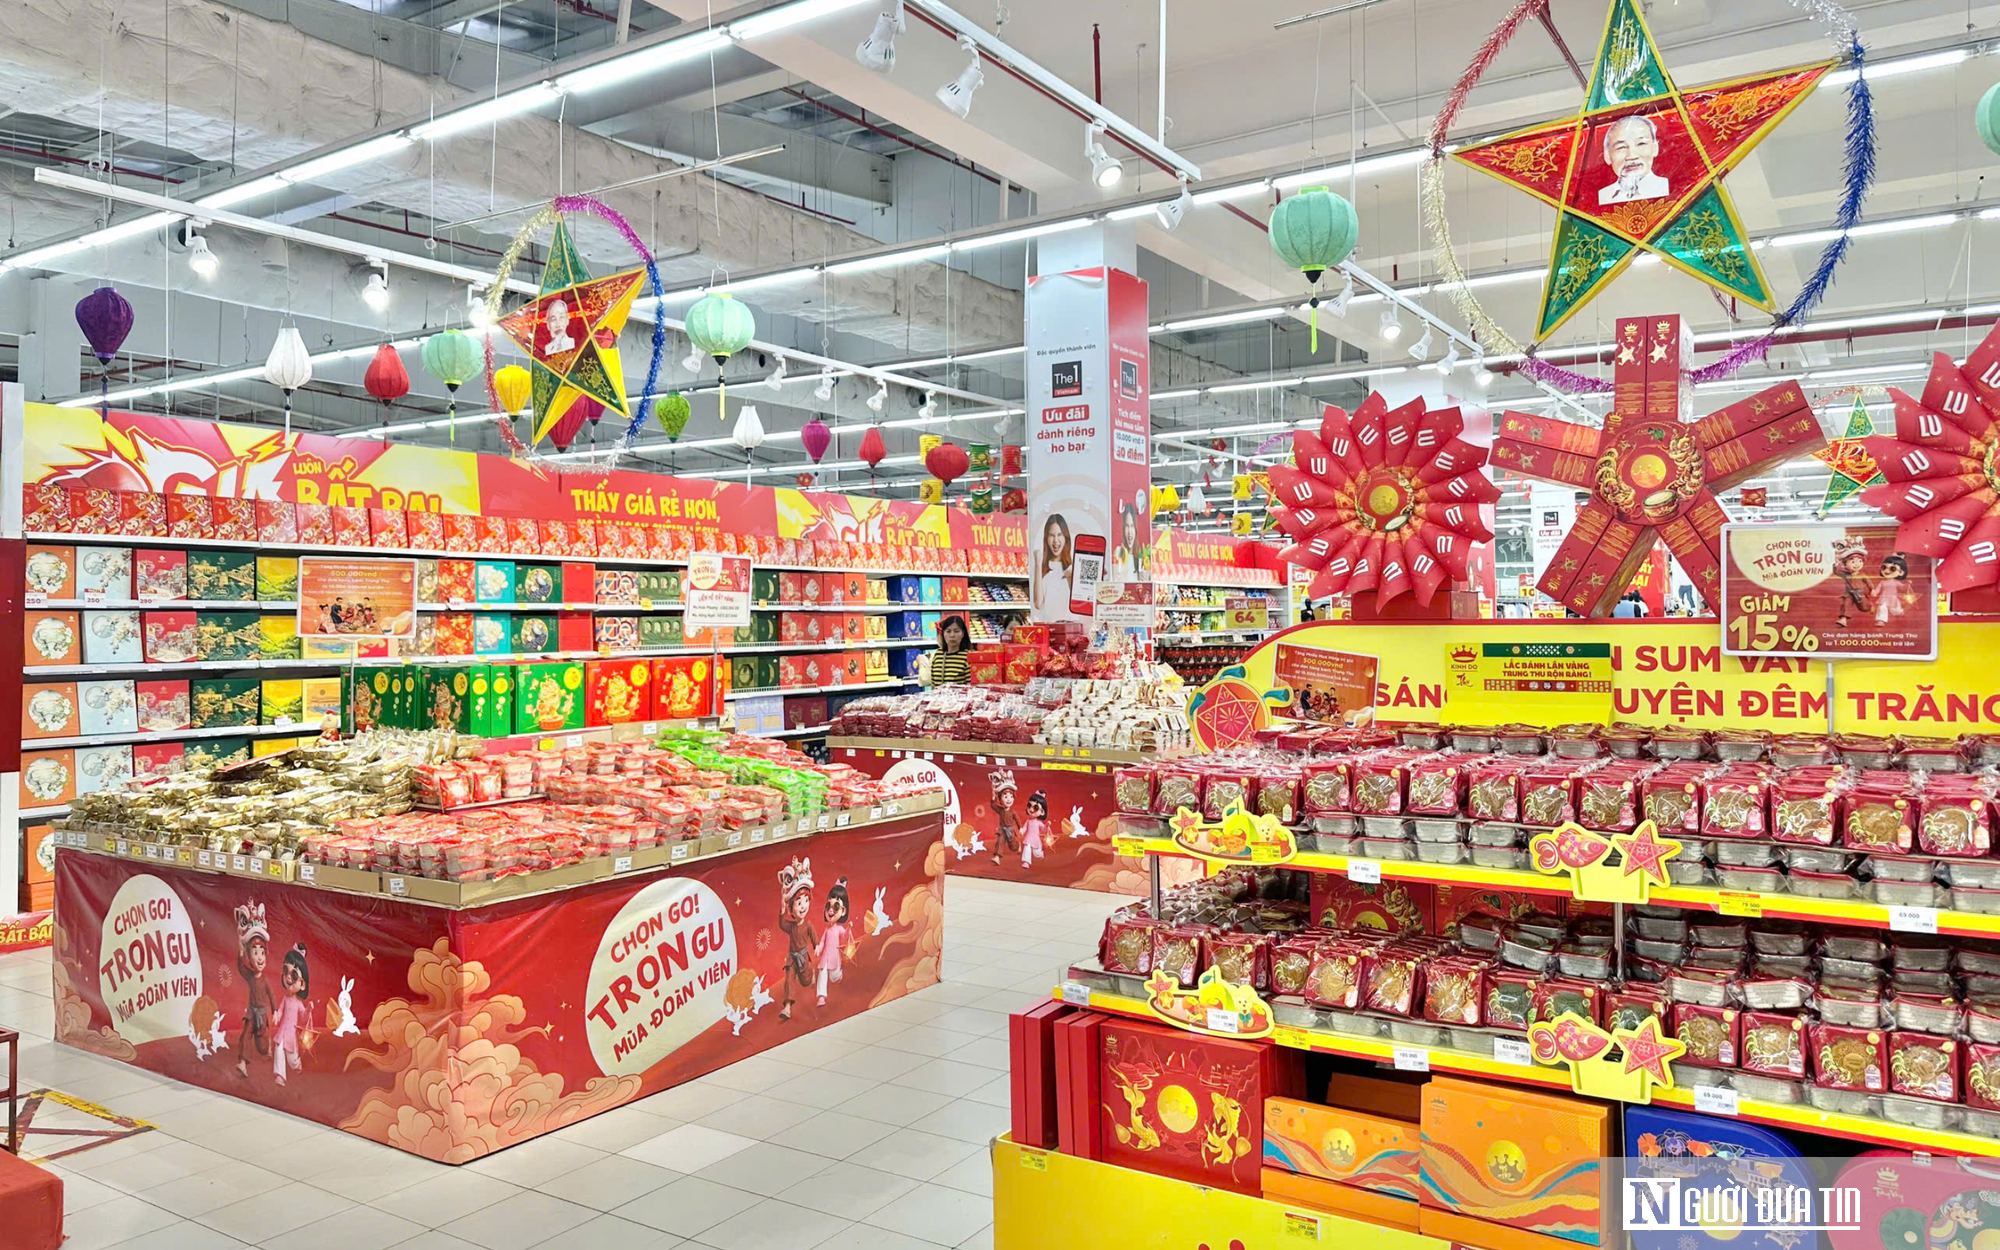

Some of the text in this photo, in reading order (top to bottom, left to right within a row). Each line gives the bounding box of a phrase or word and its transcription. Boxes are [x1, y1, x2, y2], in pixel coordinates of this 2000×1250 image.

[1943, 390, 1968, 414] LU
[1046, 407, 1085, 422] Ưu đãi
[1919, 414, 1942, 437] LU
[1037, 426, 1095, 440] dành riêng
[1902, 450, 1930, 476] LU
[570, 478, 620, 514] THẤY
[625, 488, 656, 516] GIÁ
[660, 488, 680, 518] RẺ
[684, 498, 720, 524] HƠN,
[1905, 485, 1934, 509] LU
[972, 514, 1024, 547] THẤY GIÁ
[1939, 518, 1965, 540] LU
[1197, 538, 1210, 560] GIÁ
[1766, 540, 1811, 552] CHỌN GO!
[1968, 541, 1997, 564] LU
[1752, 550, 1823, 571] TRỌN GU
[1805, 566, 1824, 576] VIÊN
[1739, 592, 1790, 613] GIẢM
[1234, 611, 1255, 623] 64
[1729, 614, 1819, 652] 15%
[1850, 632, 1866, 640] hàng
[1504, 658, 1590, 670] LẮC BÁNH LÂN VÀNG
[1634, 645, 1721, 674] SUM
[1547, 669, 1564, 679] RỘN
[1376, 676, 1448, 708] SÁN
[1738, 683, 1828, 728] ĐÊM
[917, 771, 936, 784] GO!
[114, 898, 171, 935] CHỌN GO!
[611, 893, 700, 963] CHỌN GO!
[101, 930, 191, 993] TRỌN GU
[587, 918, 725, 1031] TRỌN GU
[137, 981, 168, 1012] ĐOÀN
[171, 976, 197, 998] VIÊN
[613, 959, 730, 1063] MÙA ĐOÀN VIÊN
